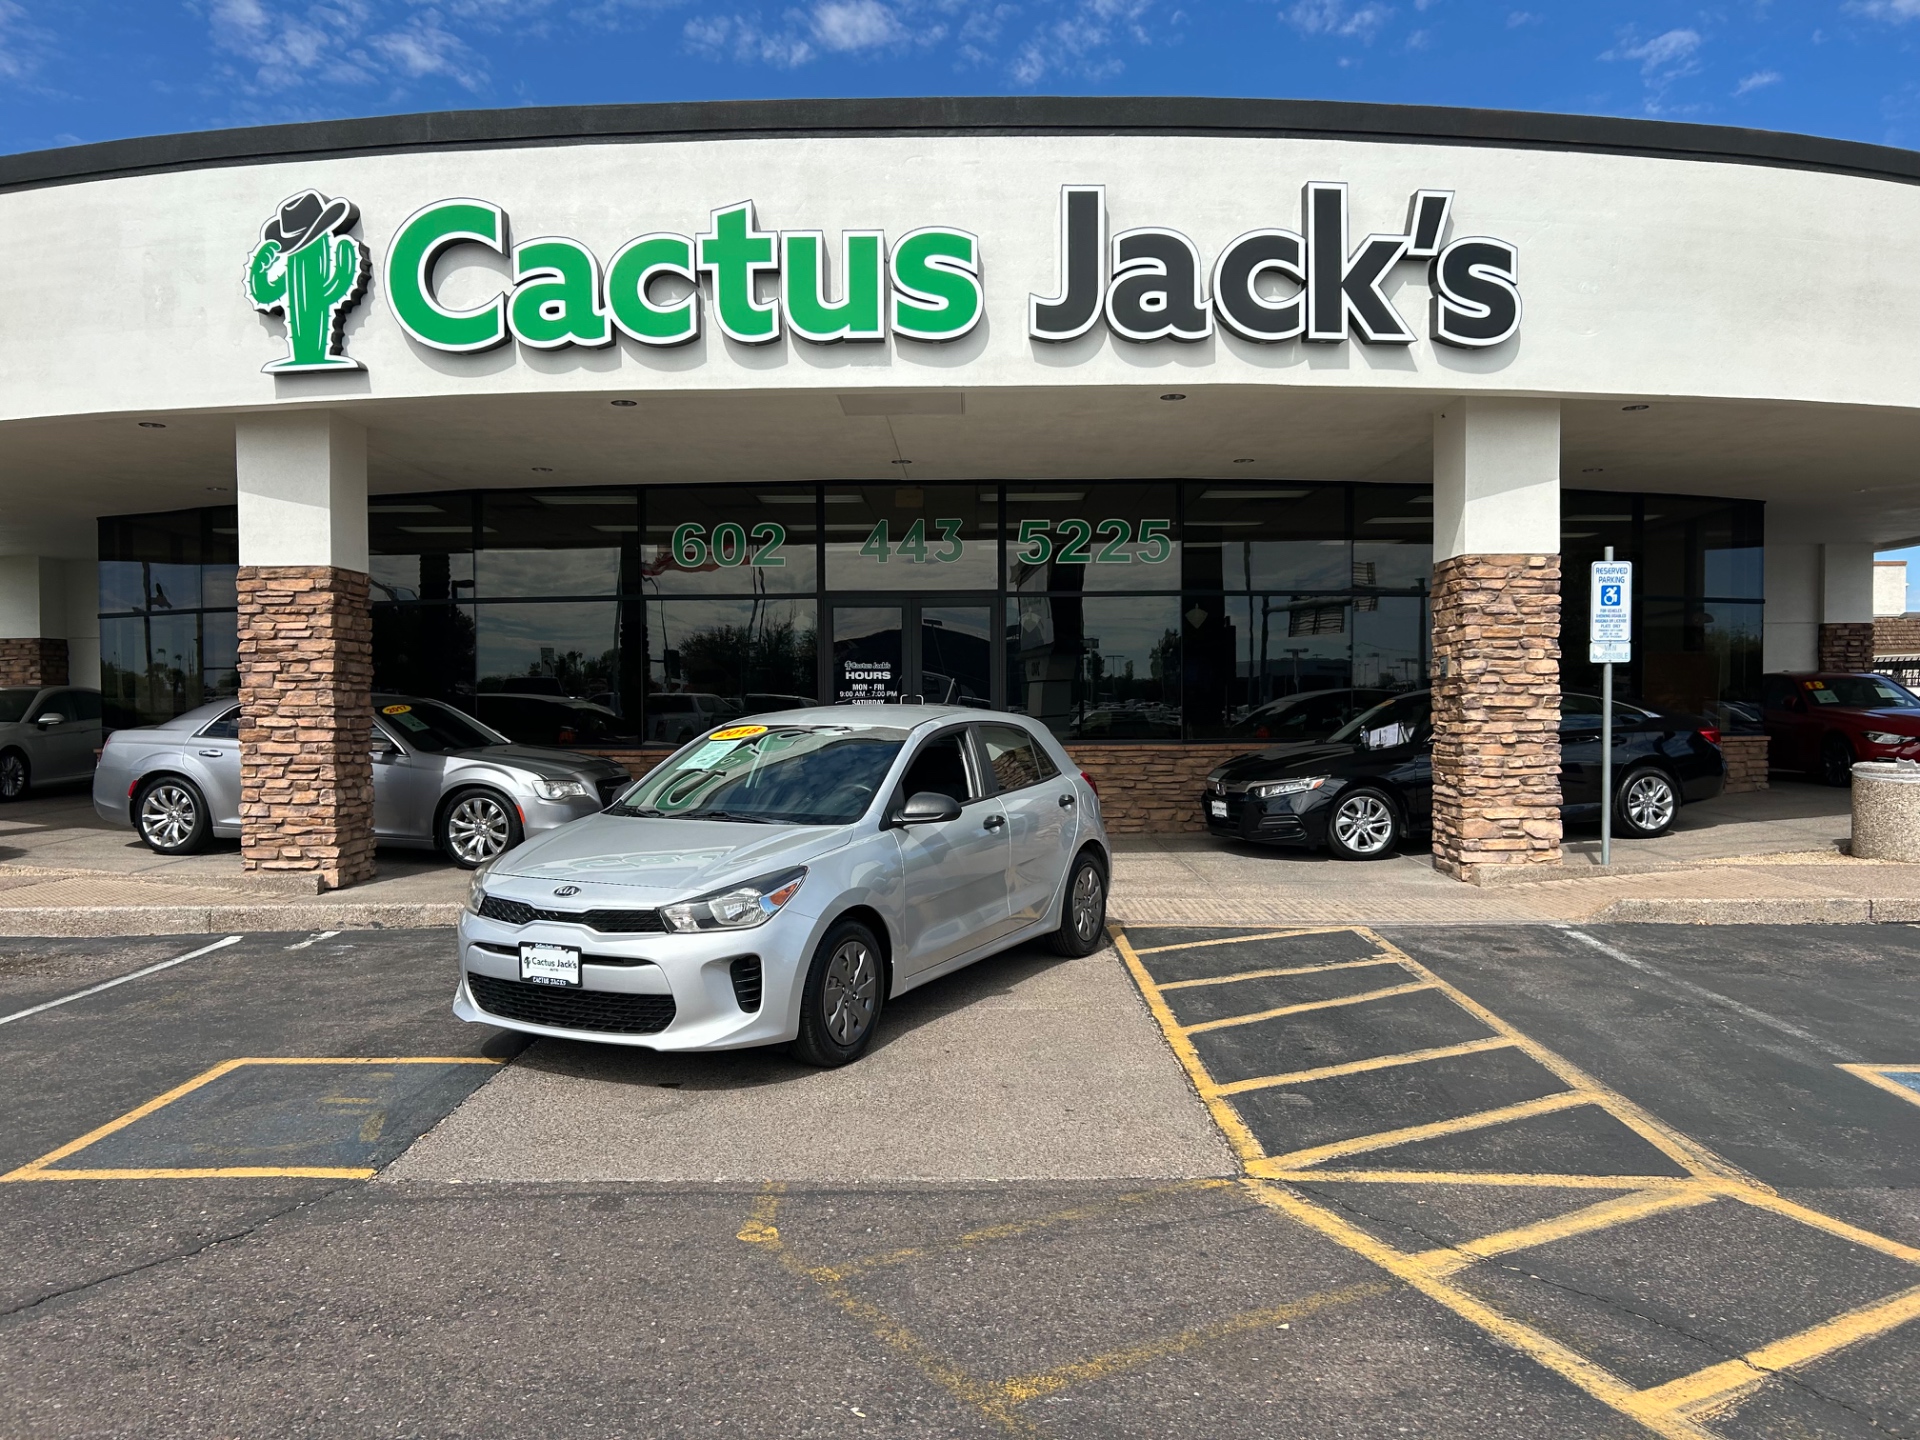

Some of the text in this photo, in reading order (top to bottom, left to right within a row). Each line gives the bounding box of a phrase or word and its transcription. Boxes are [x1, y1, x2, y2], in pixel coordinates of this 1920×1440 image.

[384, 181, 1522, 352] Cactus Jack's
[671, 518, 1172, 568] 602 443 5225
[845, 671, 891, 679] HOURS
[716, 727, 763, 738] 2018
[556, 886, 576, 895] KIA
[531, 956, 577, 969] Cactus Jack's
